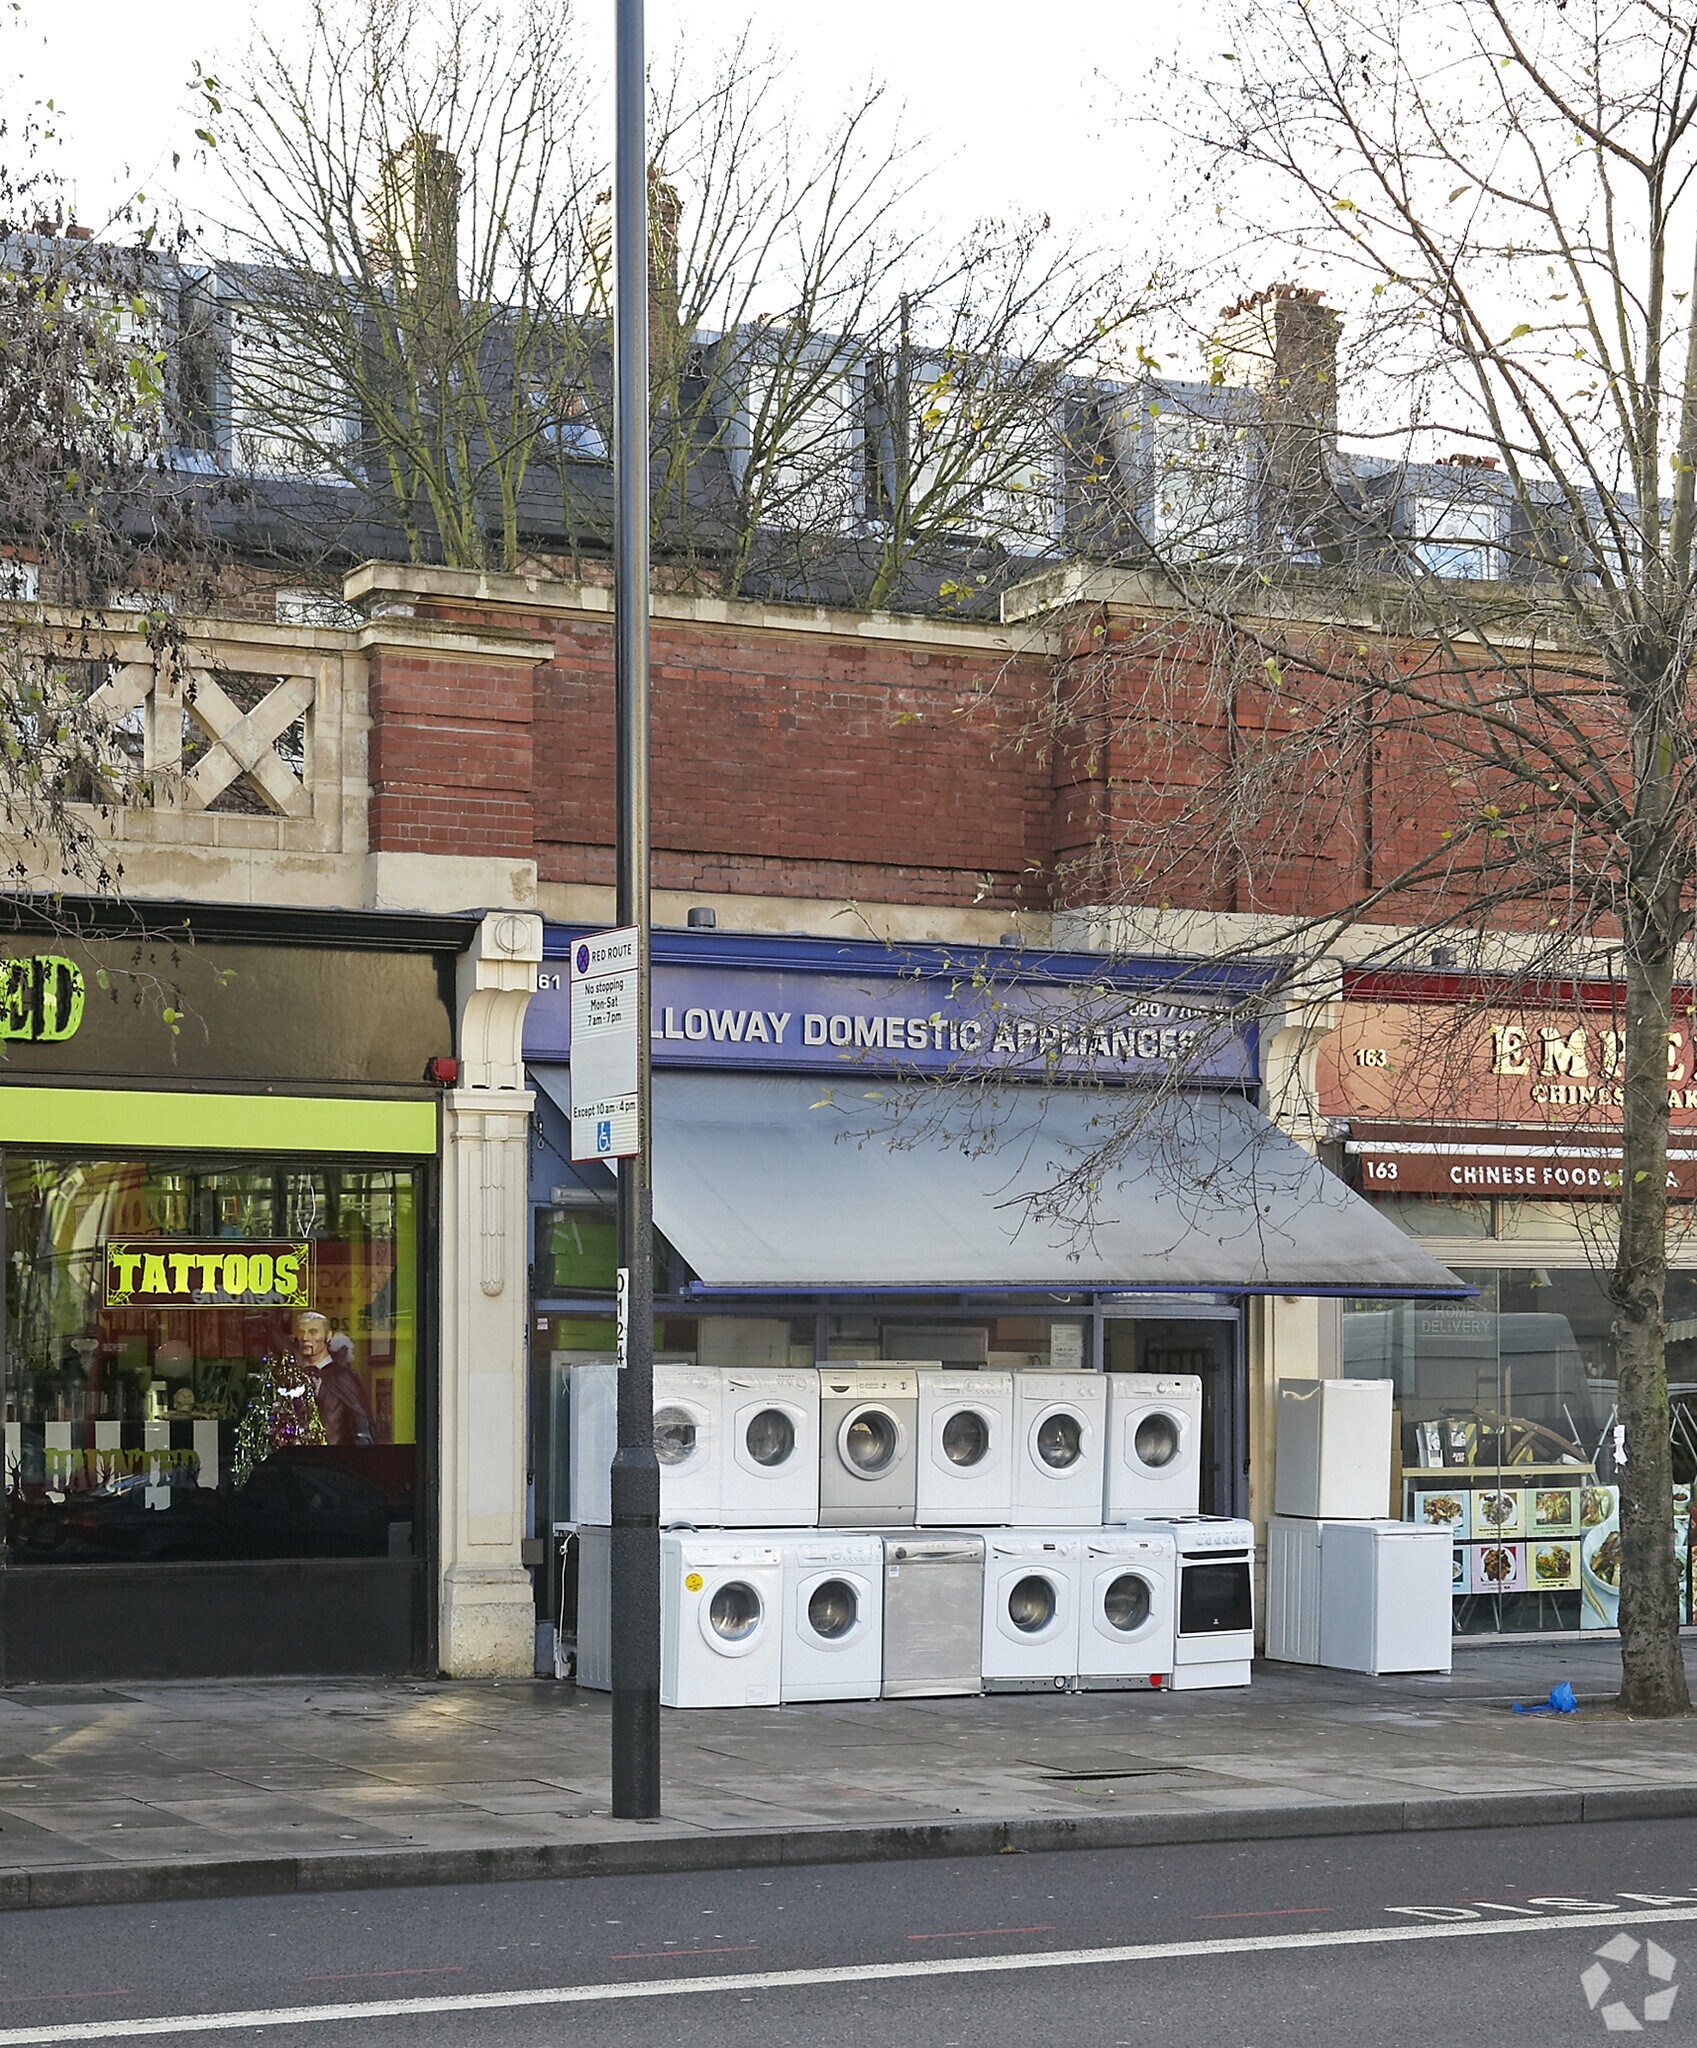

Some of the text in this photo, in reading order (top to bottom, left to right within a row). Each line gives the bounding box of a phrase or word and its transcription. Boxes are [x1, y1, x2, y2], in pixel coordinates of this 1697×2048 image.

[591, 943, 632, 962] RED ROUTE
[584, 979, 624, 996] No stopping
[803, 1013, 983, 1051] DOMESTIC
[1355, 1048, 1388, 1068] 163
[573, 1104, 595, 1118] Except
[1366, 1161, 1399, 1180] 163
[1450, 1165, 1537, 1185] CHINESE
[112, 1252, 301, 1295] TATTOOS
[1435, 1305, 1475, 1319] HOME
[1384, 1887, 1697, 1921] DISA
